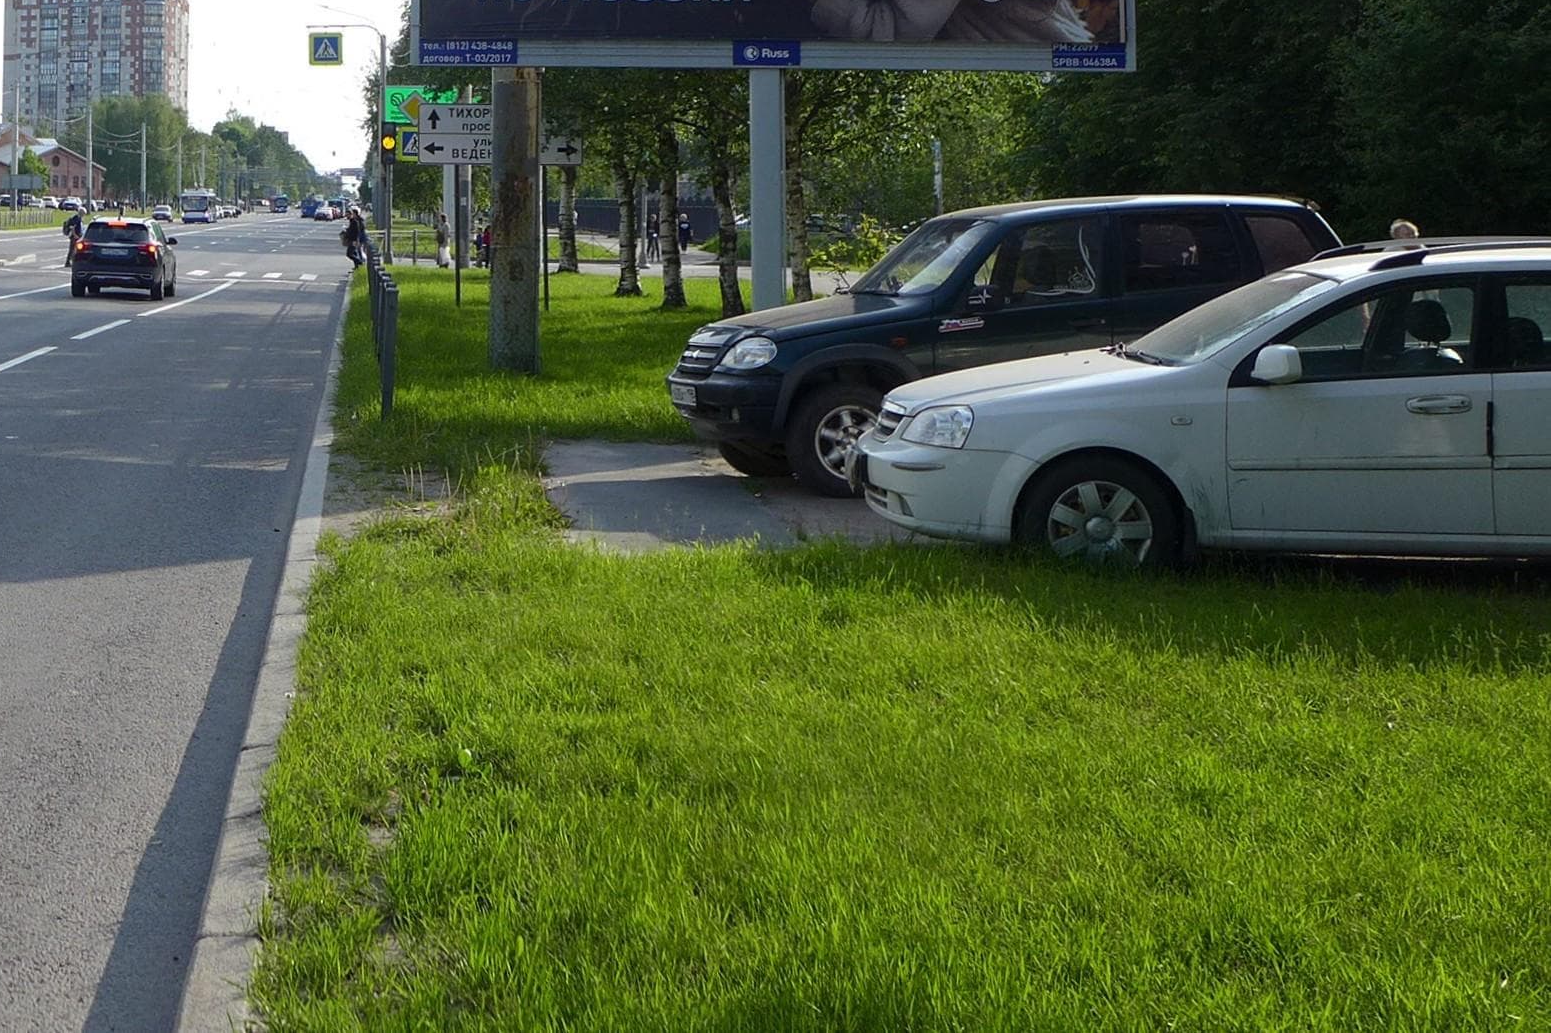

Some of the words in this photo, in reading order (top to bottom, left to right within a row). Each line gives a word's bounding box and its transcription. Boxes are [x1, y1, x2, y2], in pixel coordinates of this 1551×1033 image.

[446, 41, 469, 50] (812)
[761, 48, 790, 58] Russ
[422, 54, 463, 64] договор:
[448, 108, 492, 118] ТИХОР
[462, 123, 491, 133] прос
[473, 139, 492, 148] ули
[452, 149, 492, 160] ВЕДЕН
